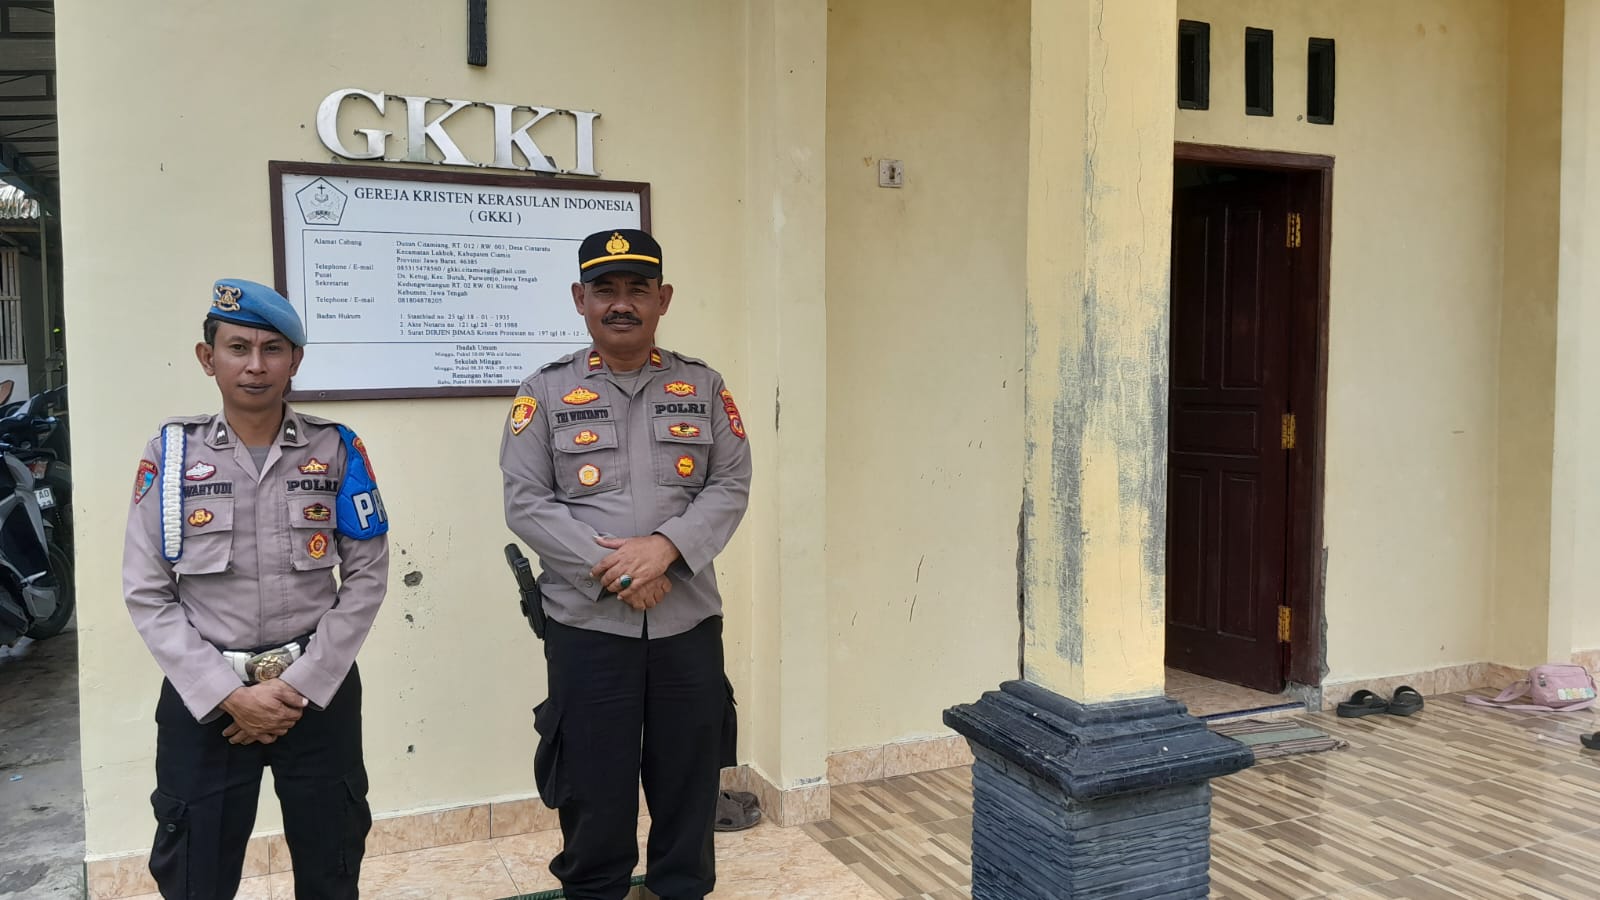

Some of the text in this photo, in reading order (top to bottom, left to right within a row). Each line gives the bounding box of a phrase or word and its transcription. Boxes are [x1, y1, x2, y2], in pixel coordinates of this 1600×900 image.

[316, 88, 602, 177] GKKI
[354, 187, 634, 212] GEREJA KRISTEN KERASULAN INDONESIA
[339, 239, 362, 247] Cabang
[457, 251, 489, 259] Kabupaten
[315, 263, 347, 272] Telephone
[517, 276, 538, 284] Tengah
[446, 290, 469, 298] Tengah
[316, 296, 348, 304] Telephone
[452, 372, 482, 380] Renungan
[655, 404, 707, 414] POLRI
[183, 482, 233, 499] WAHYUDI
[286, 480, 338, 493] POLRI
